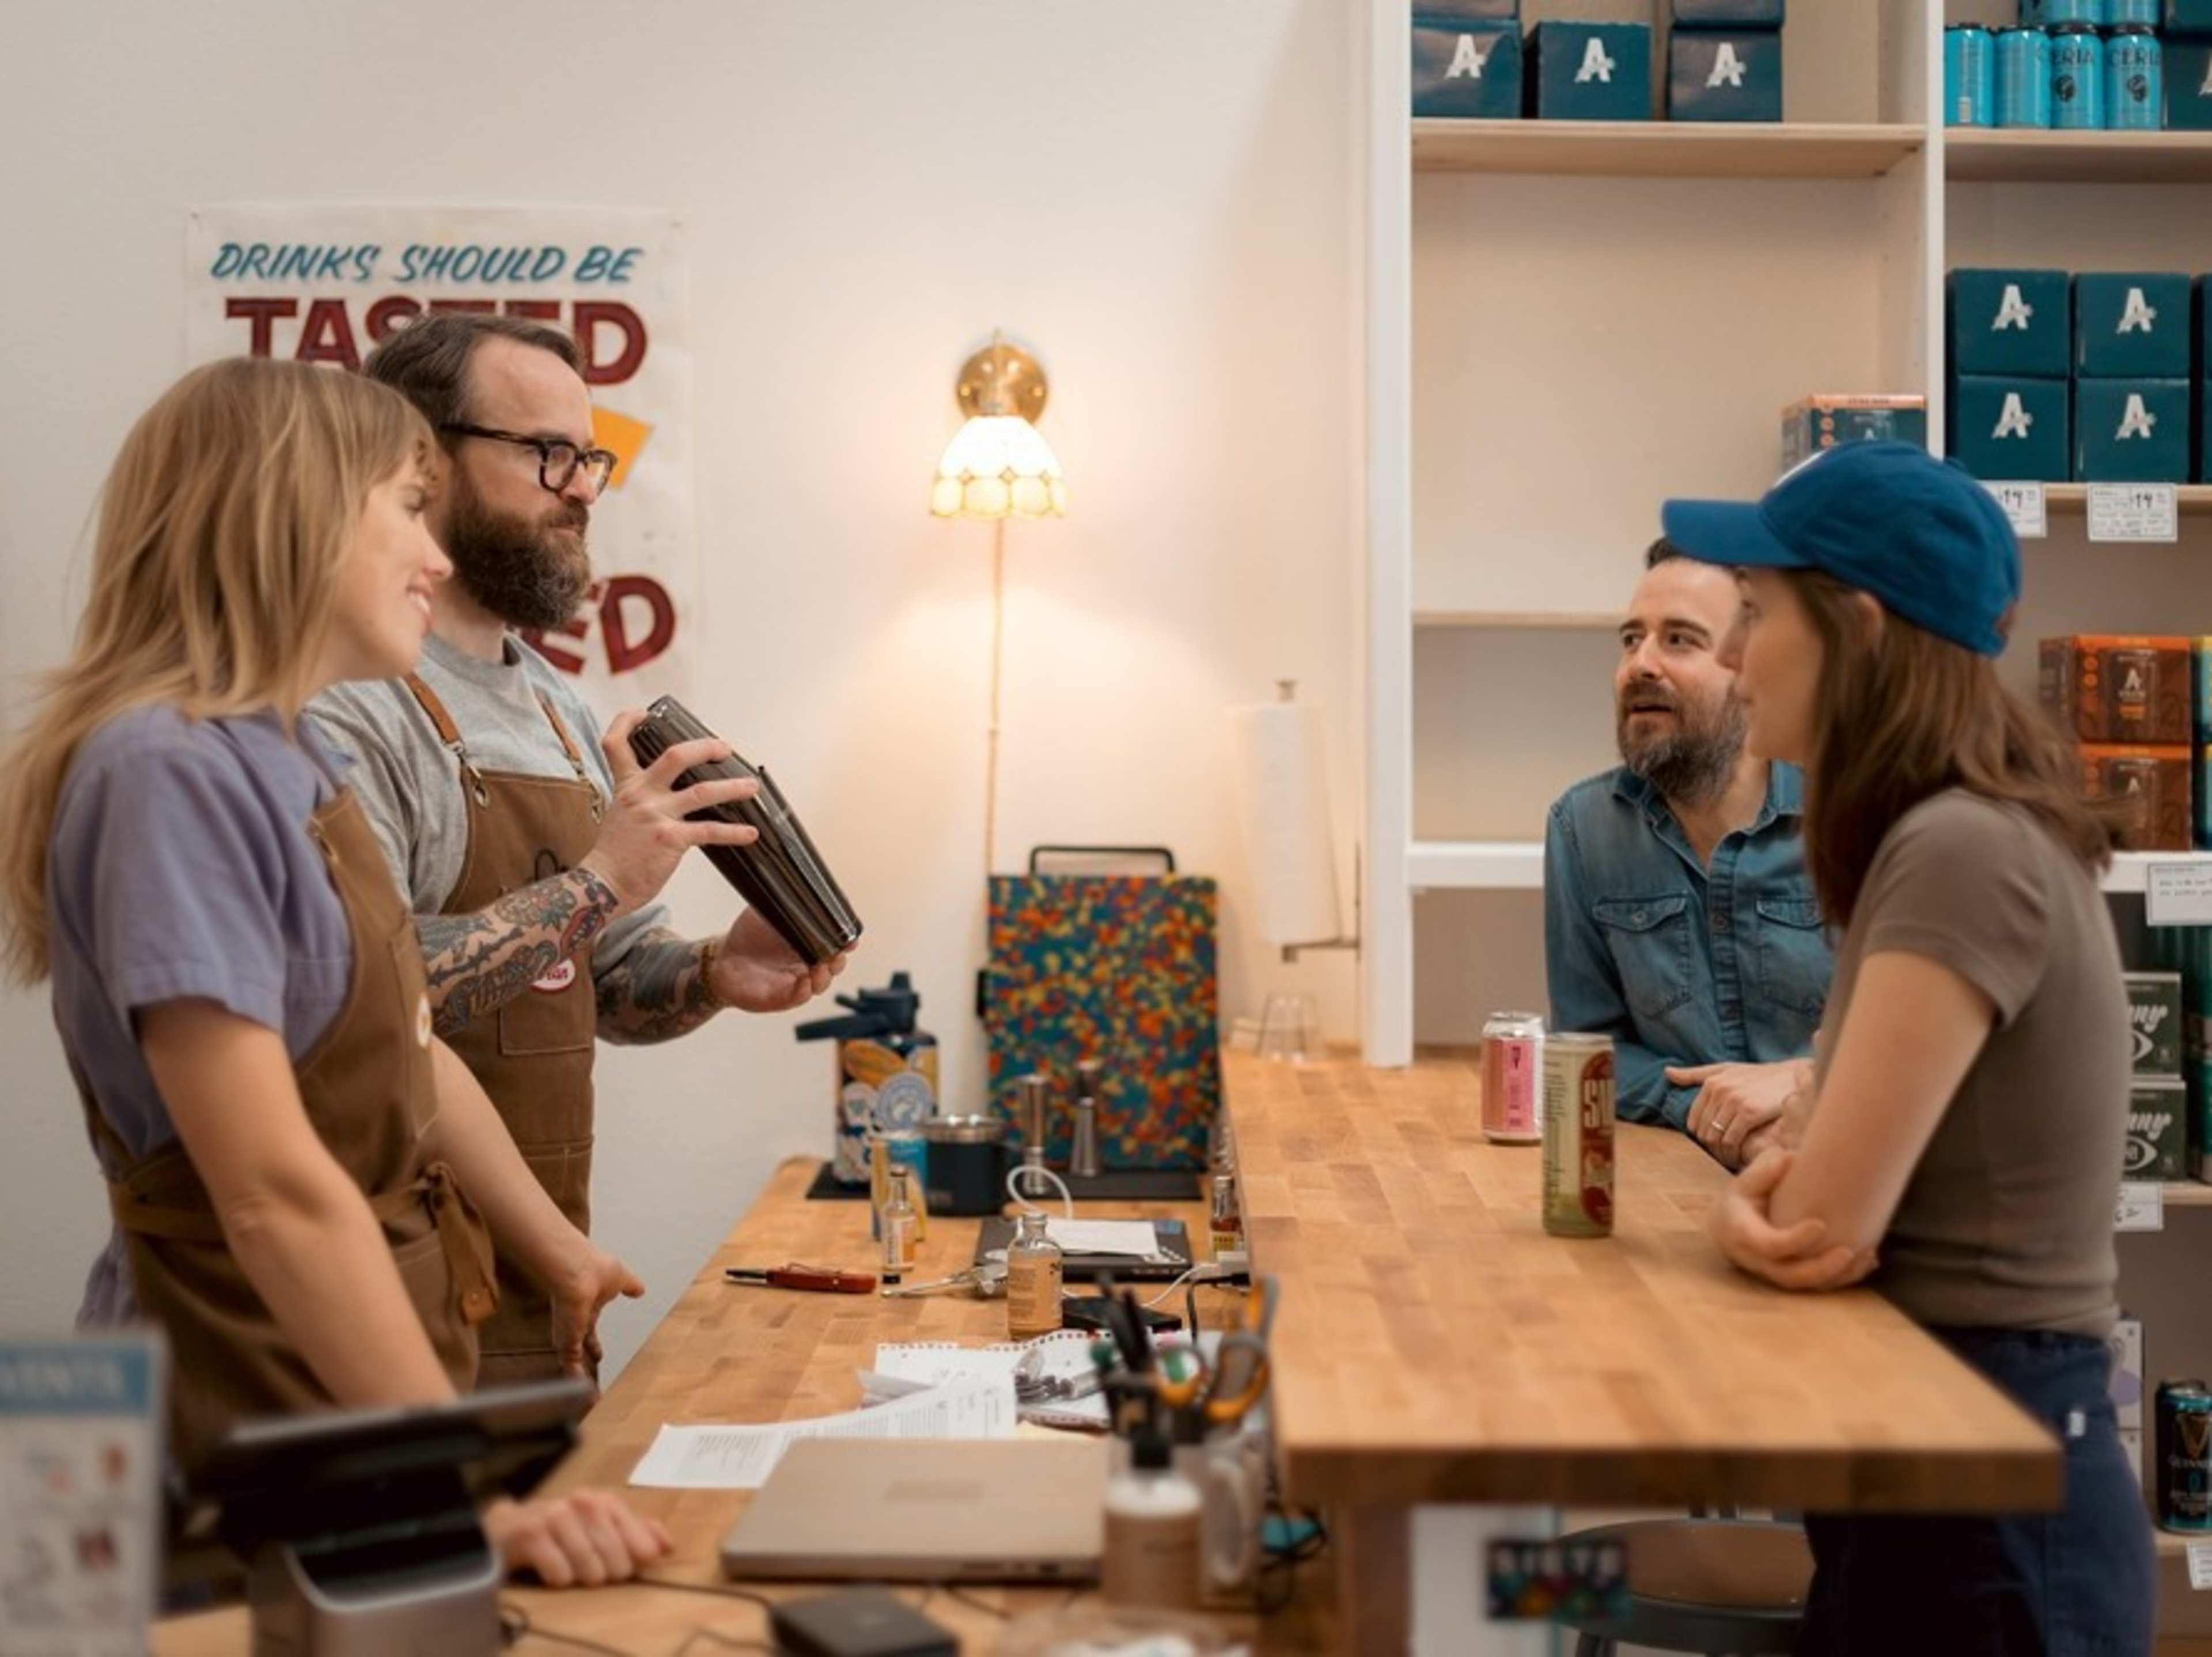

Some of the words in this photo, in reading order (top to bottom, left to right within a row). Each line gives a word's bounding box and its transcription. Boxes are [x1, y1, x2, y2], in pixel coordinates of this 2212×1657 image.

[210, 243, 381, 280] DRINKS
[393, 244, 566, 282] SHOULD
[573, 245, 645, 282] BE
